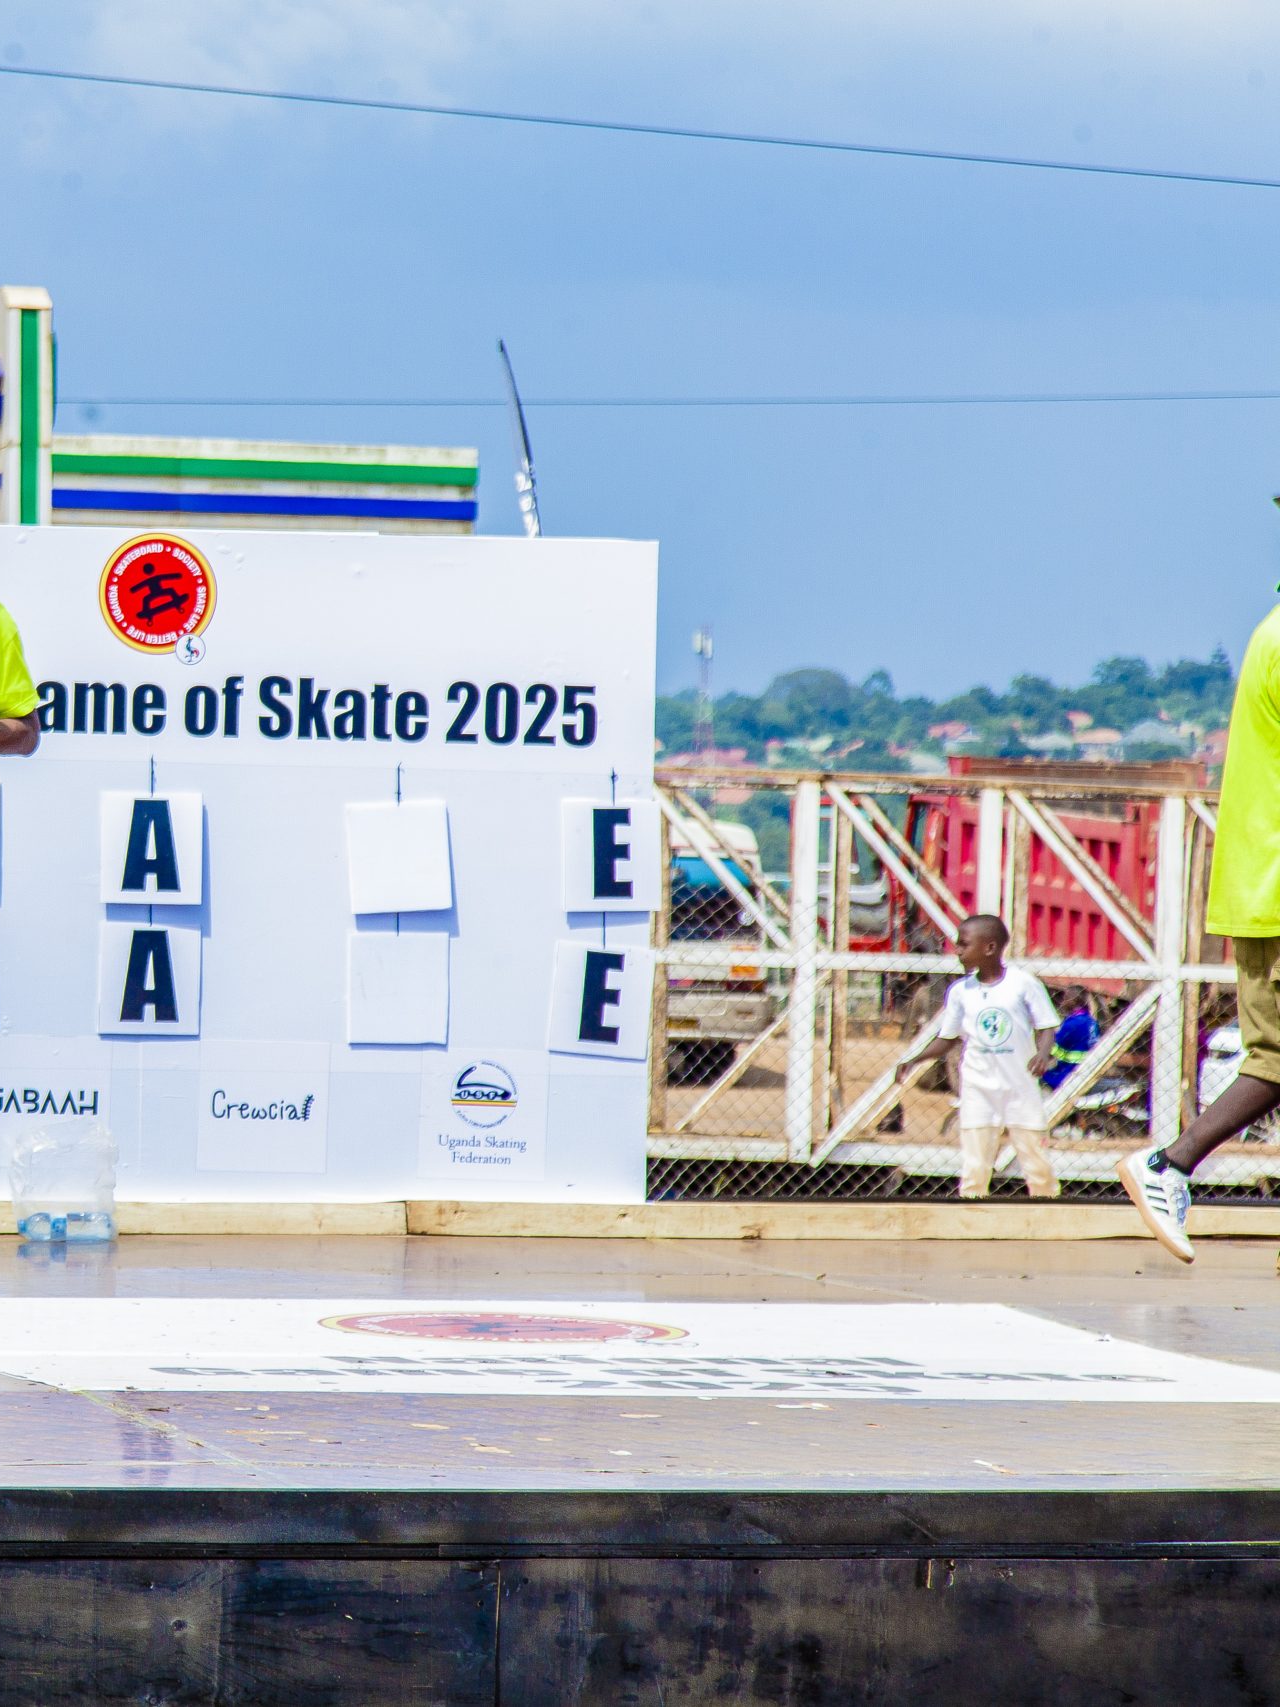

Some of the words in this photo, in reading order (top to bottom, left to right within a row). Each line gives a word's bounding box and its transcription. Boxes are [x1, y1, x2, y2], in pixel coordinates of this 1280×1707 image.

[113, 543, 164, 576] SKATEBOARD
[172, 547, 203, 577] SOCIETY
[107, 584, 125, 623] UGANDA
[195, 586, 207, 615] SKATE
[126, 625, 146, 642] LIFE
[183, 612, 201, 632] LIFE
[144, 631, 179, 645] BETTER
[37, 681, 167, 737] ame
[184, 675, 244, 738] of
[258, 675, 430, 743] Skate
[445, 681, 598, 749] 2025
[121, 799, 179, 892] A
[592, 808, 633, 898] E
[119, 929, 178, 1022] A
[578, 950, 625, 1043] E
[438, 1134, 481, 1151] Uganda
[484, 1136, 528, 1154] Skating
[452, 1151, 512, 1165] Federation
